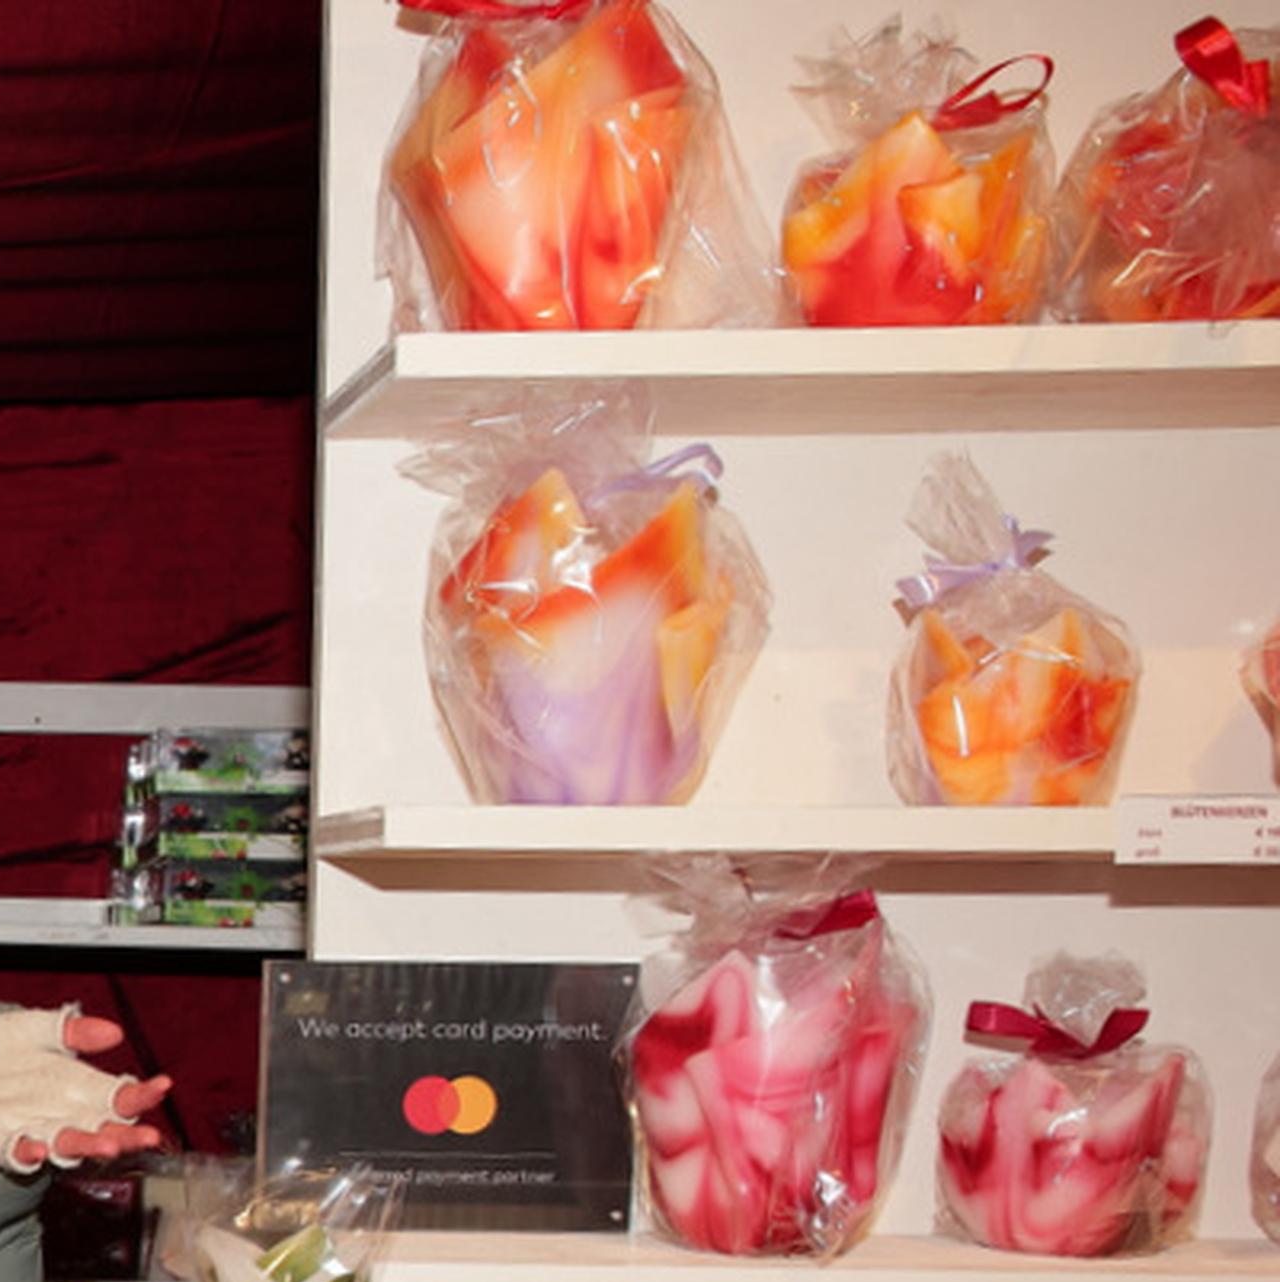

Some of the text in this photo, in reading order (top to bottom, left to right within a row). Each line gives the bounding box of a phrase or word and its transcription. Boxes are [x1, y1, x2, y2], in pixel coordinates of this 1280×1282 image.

[298, 1018, 338, 1038] We
[345, 1021, 425, 1042] accept
[432, 1020, 487, 1039] card
